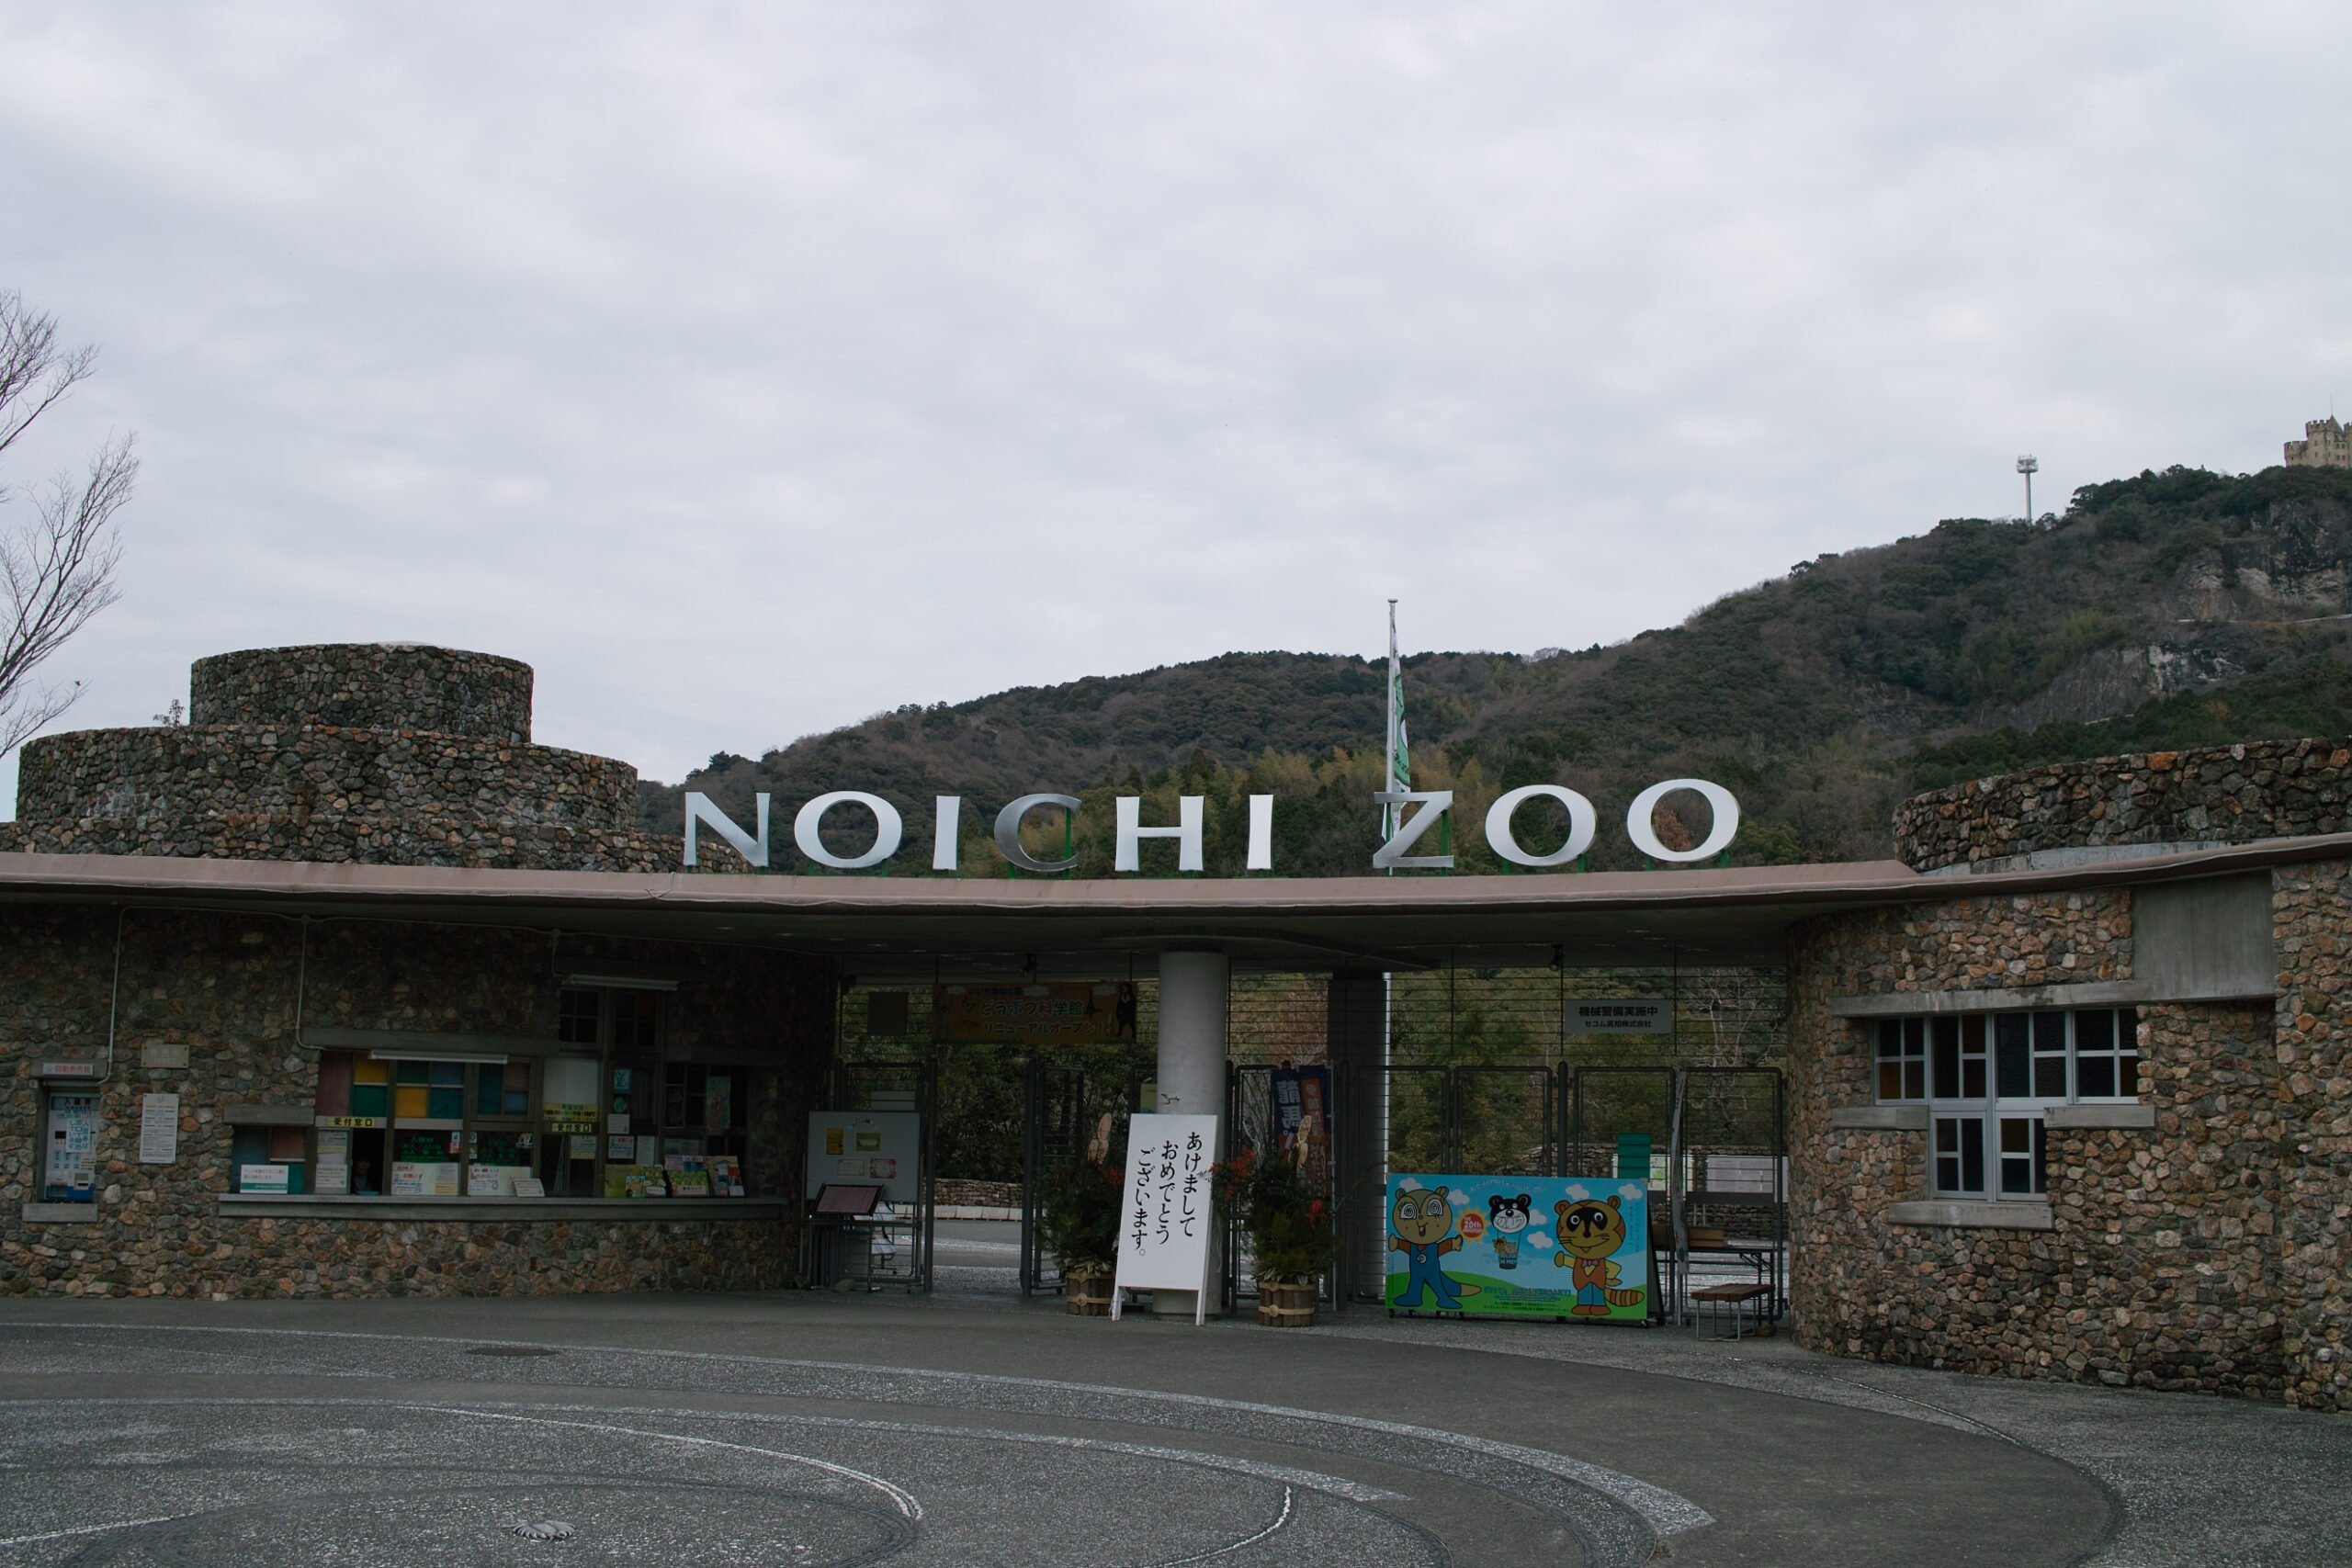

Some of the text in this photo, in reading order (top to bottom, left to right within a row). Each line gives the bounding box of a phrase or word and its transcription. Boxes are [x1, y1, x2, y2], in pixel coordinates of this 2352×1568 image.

[683, 778, 1742, 872] NOICHI ZOO
[979, 999, 1084, 1017] どうぶつ科学館
[1578, 1006, 1658, 1017] 機械警備実施中
[334, 1117, 373, 1127] 受付窓口
[558, 1123, 590, 1132] 受付窓口
[1131, 1146, 1156, 1257] ございます。
[1156, 1140, 1179, 1245] おめでとう
[1180, 1132, 1203, 1237] あけまして
